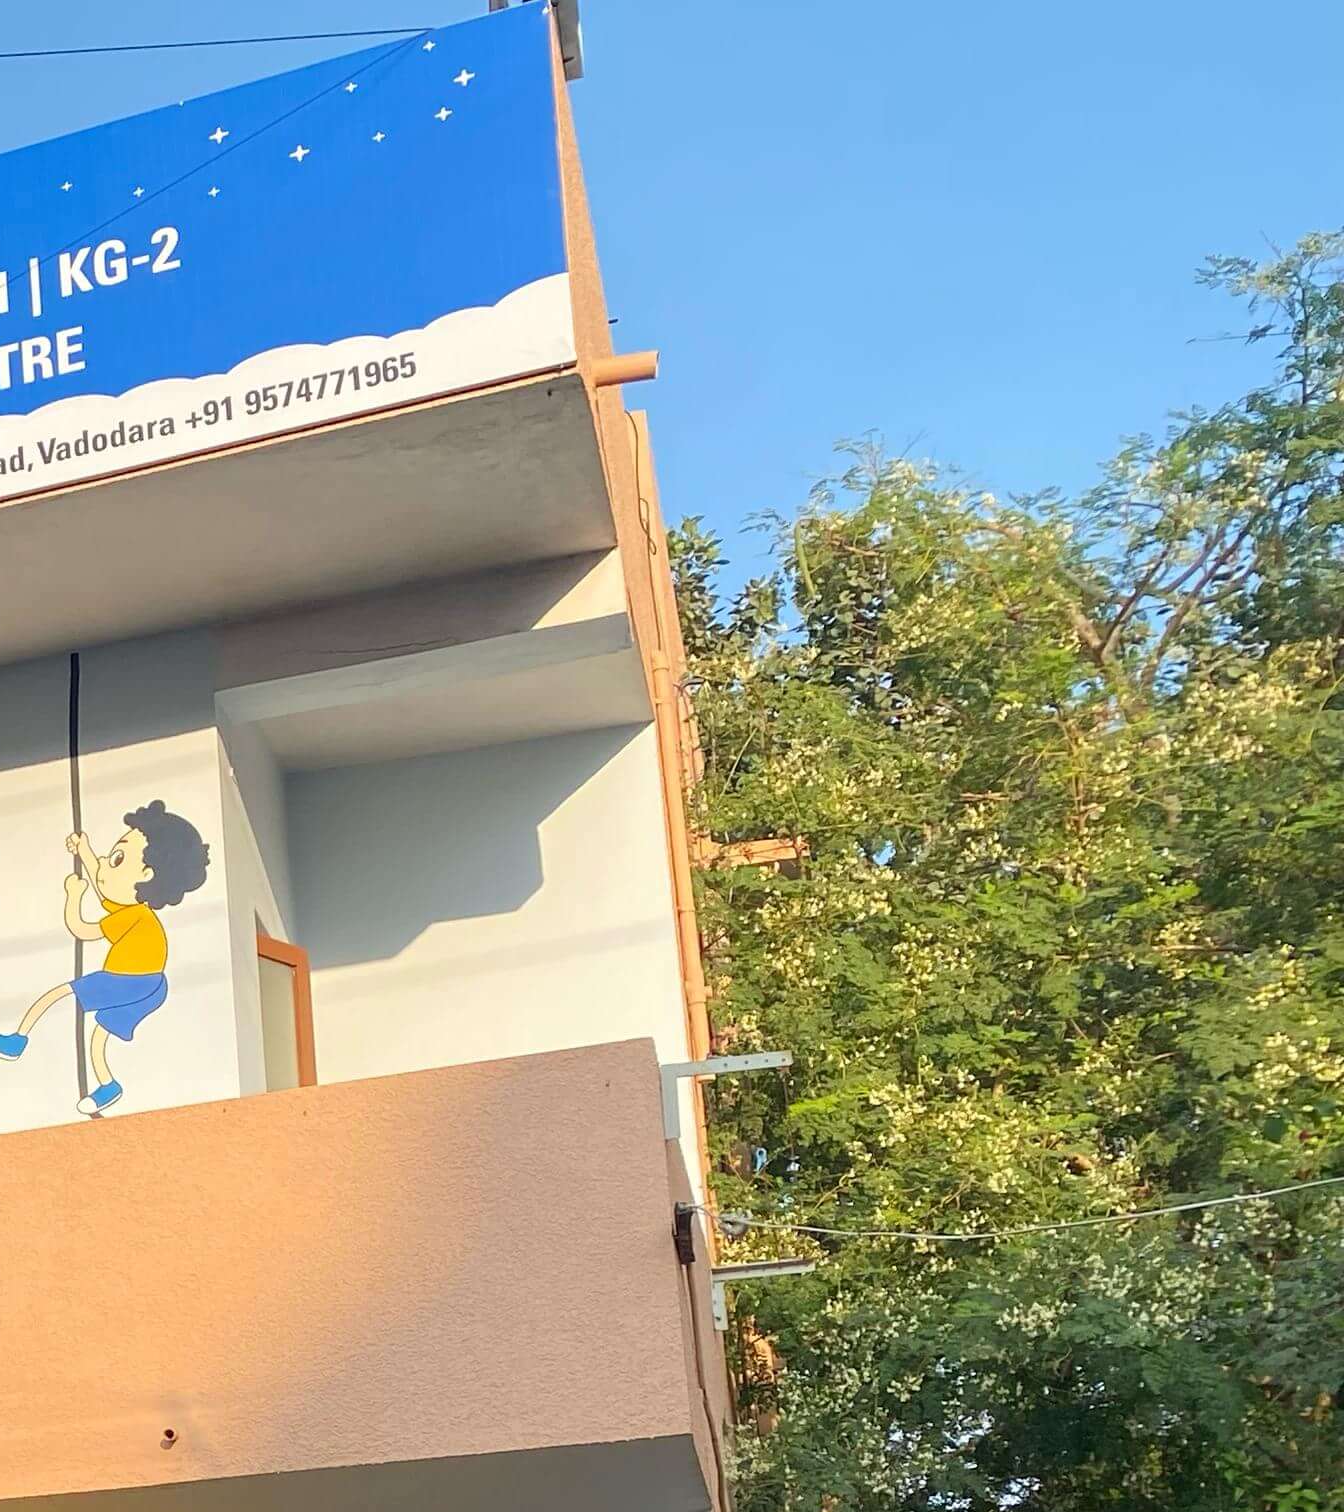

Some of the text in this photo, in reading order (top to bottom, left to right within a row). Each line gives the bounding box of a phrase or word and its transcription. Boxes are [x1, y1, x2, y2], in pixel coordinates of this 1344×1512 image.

[58, 226, 182, 298] KG-2
[37, 416, 175, 465] Vadodara
[184, 396, 233, 429] +91
[245, 352, 417, 416] 9574771965
